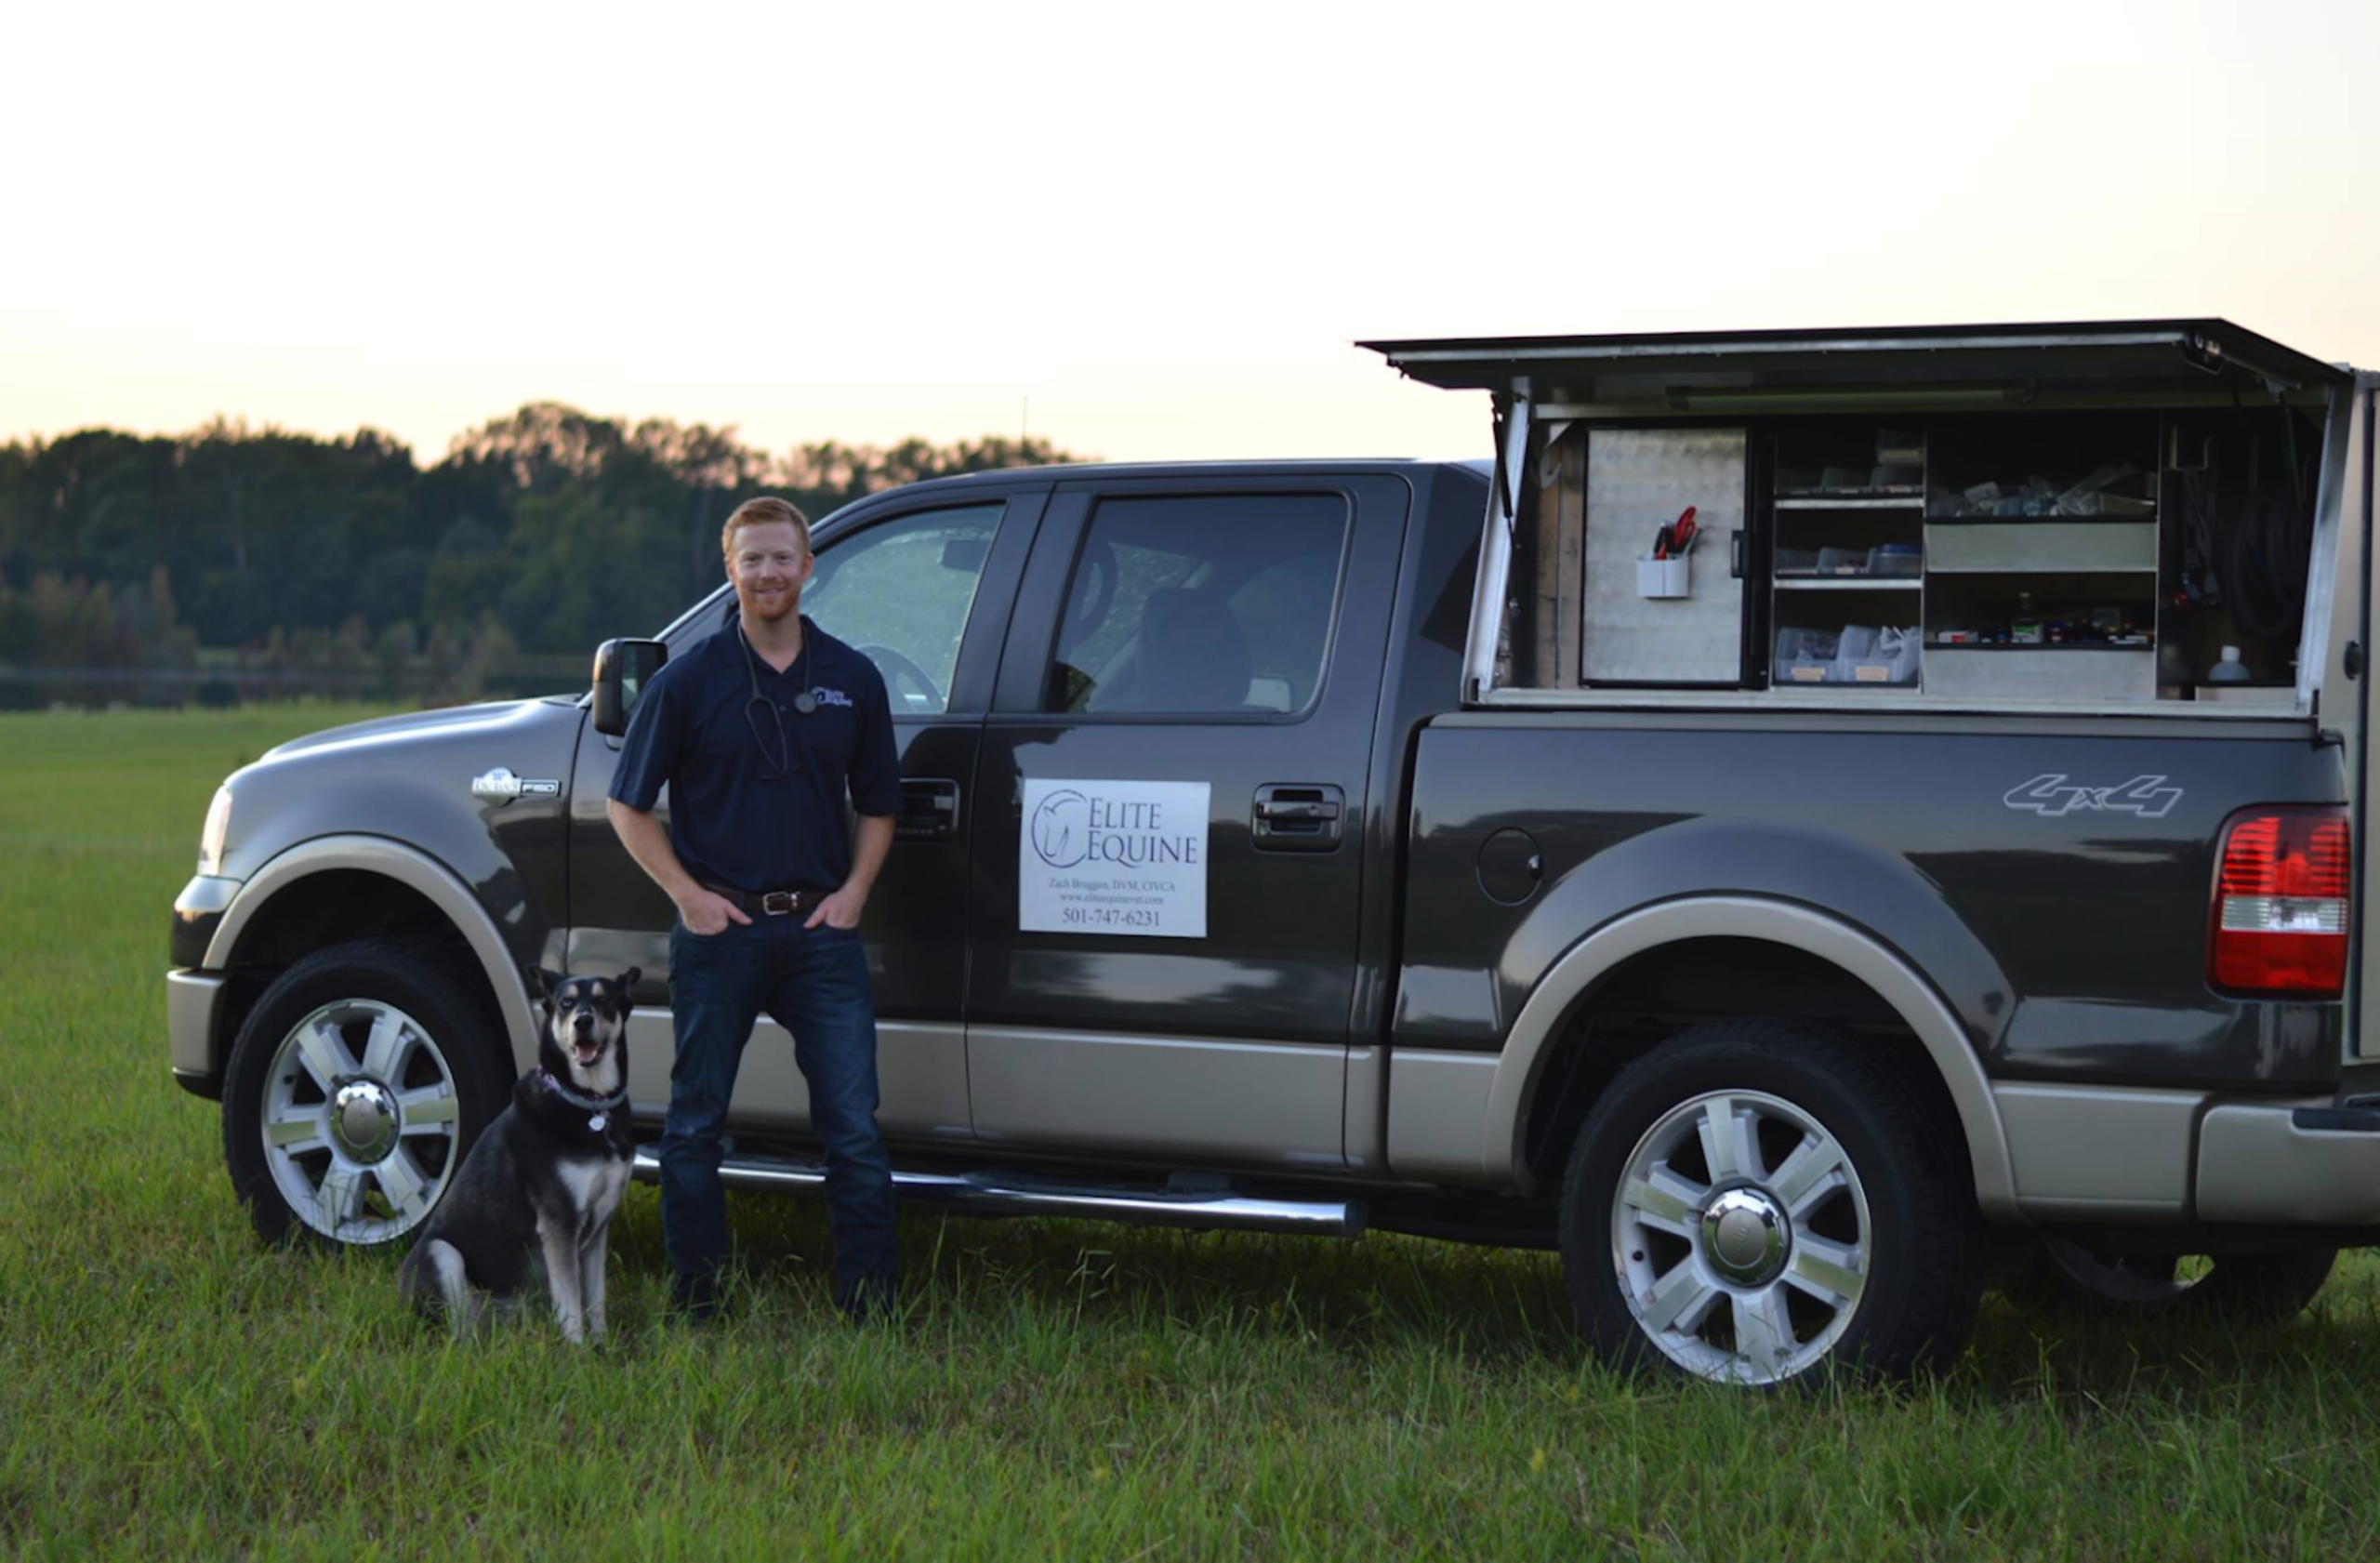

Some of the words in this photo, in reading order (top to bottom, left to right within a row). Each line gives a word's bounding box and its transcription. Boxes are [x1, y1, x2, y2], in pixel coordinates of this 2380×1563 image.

[2003, 774, 2184, 817] 4x4
[1088, 797, 1162, 830] ELITE
[1088, 829, 1198, 869] EQUINE
[1048, 877, 1070, 889] Zach
[1112, 880, 1140, 891] DVM,
[1060, 894, 1165, 906] www.eliteequinevet.com
[1061, 907, 1160, 927] 501-747-6231
